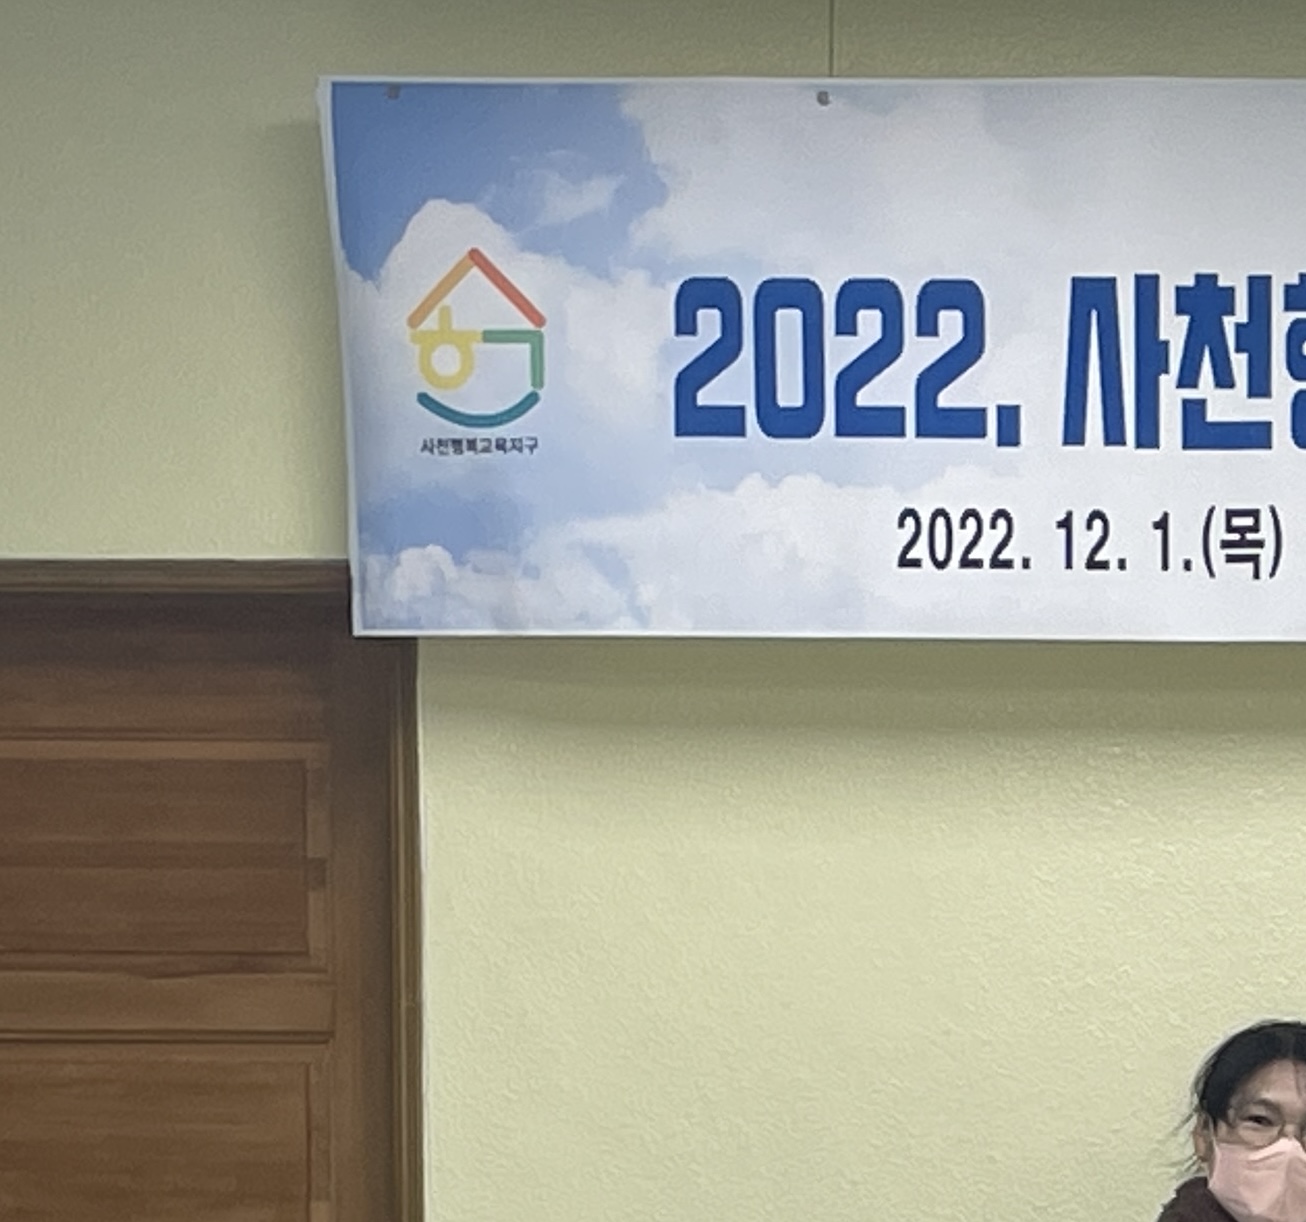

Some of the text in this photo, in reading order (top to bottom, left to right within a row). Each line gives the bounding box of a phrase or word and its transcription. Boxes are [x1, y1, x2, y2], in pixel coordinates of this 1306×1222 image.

[673, 276, 1019, 446] 2022.
[420, 436, 540, 455] 사천행복교육지구
[896, 507, 1032, 571] 2022.
[1055, 508, 1128, 572] 12.
[1151, 504, 1283, 581] 1.(목)
